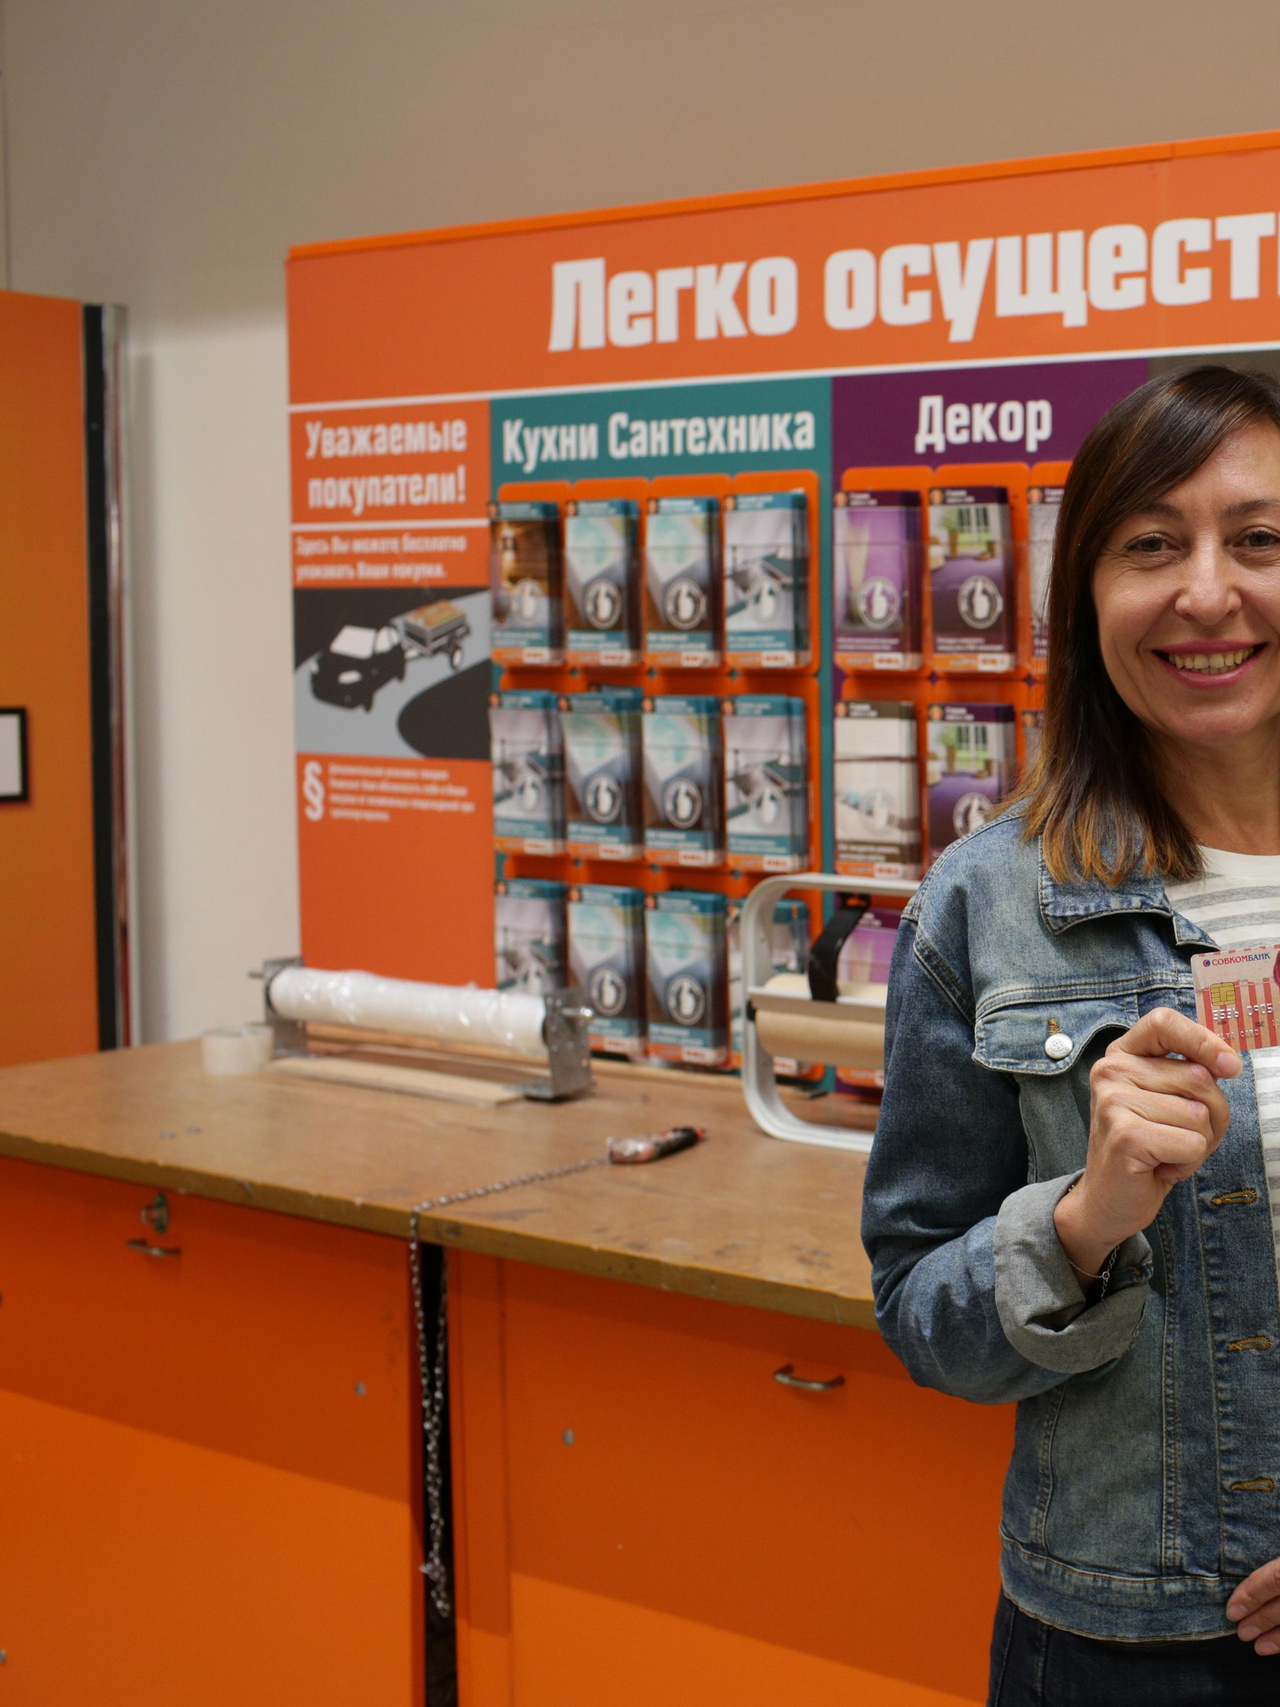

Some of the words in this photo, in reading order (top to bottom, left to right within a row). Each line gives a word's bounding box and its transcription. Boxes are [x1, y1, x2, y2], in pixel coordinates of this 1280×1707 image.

[548, 256, 798, 353] Легко
[305, 419, 467, 460] Уважаемые
[503, 419, 599, 474] Кухни
[608, 410, 815, 459] Сантехника
[914, 394, 1053, 454] Декор
[308, 465, 466, 516] покупатели!
[1212, 953, 1270, 966] СОВКОМБАНК
